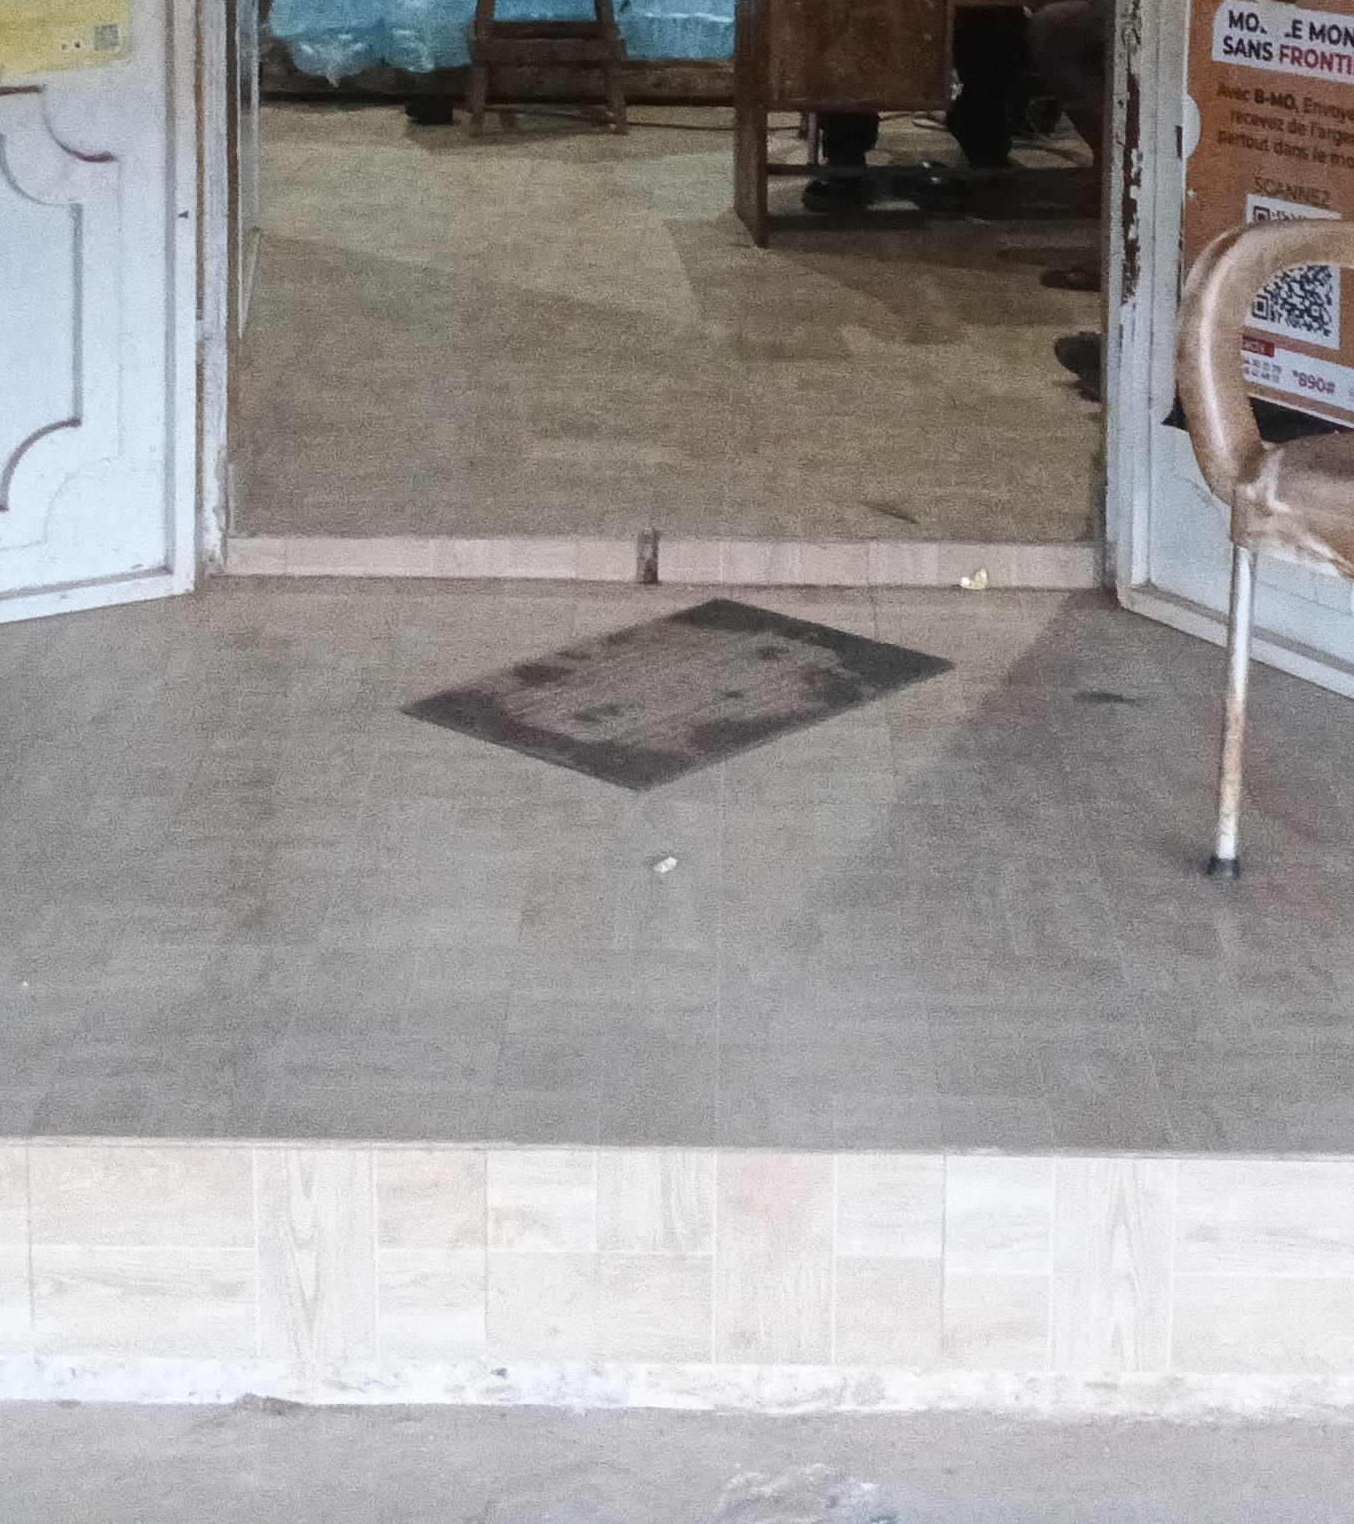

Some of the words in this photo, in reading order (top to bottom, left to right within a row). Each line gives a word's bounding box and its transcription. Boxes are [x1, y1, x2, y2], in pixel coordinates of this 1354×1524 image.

[1223, 36, 1273, 61] SANS
[1230, 109, 1284, 132] recevez
[1286, 118, 1307, 136] de
[1216, 129, 1270, 152] partout
[1273, 139, 1310, 161] dans
[1312, 150, 1326, 164] le
[1254, 176, 1332, 207] SCANNEZ
